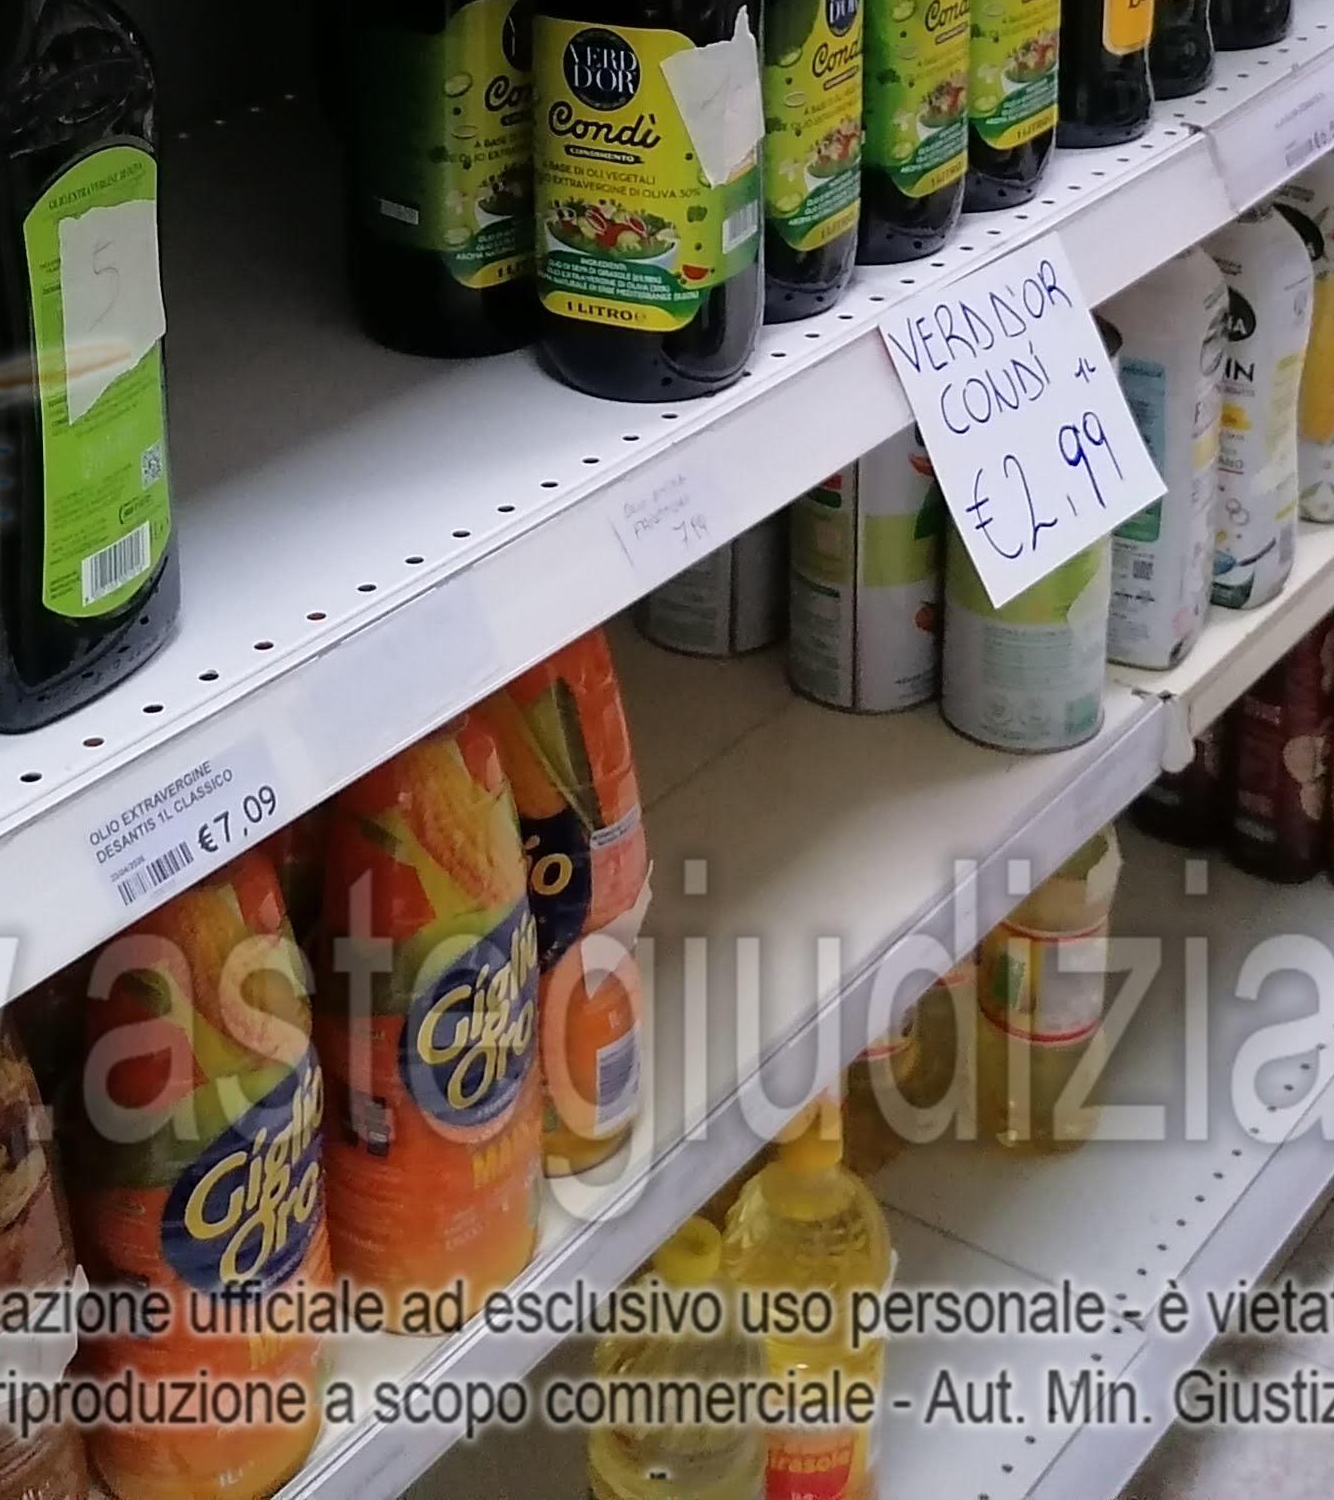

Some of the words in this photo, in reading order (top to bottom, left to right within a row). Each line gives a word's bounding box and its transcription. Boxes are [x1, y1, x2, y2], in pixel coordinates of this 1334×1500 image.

[571, 63, 636, 97] D'OR
[547, 99, 663, 151] Condì
[606, 170, 657, 186] VEGETALI
[633, 186, 642, 198] DI
[641, 187, 678, 200] OLIVA
[91, 239, 122, 332] 5
[578, 301, 634, 322] LITRO
[964, 410, 1125, 560] €2,99
[89, 818, 120, 846] OLIO
[121, 759, 213, 827] EXTRAVERGINE
[96, 819, 157, 865] DESANTIS
[157, 809, 174, 826] 1L
[173, 768, 234, 814] CLASSICO
[196, 784, 278, 854] €7,09
